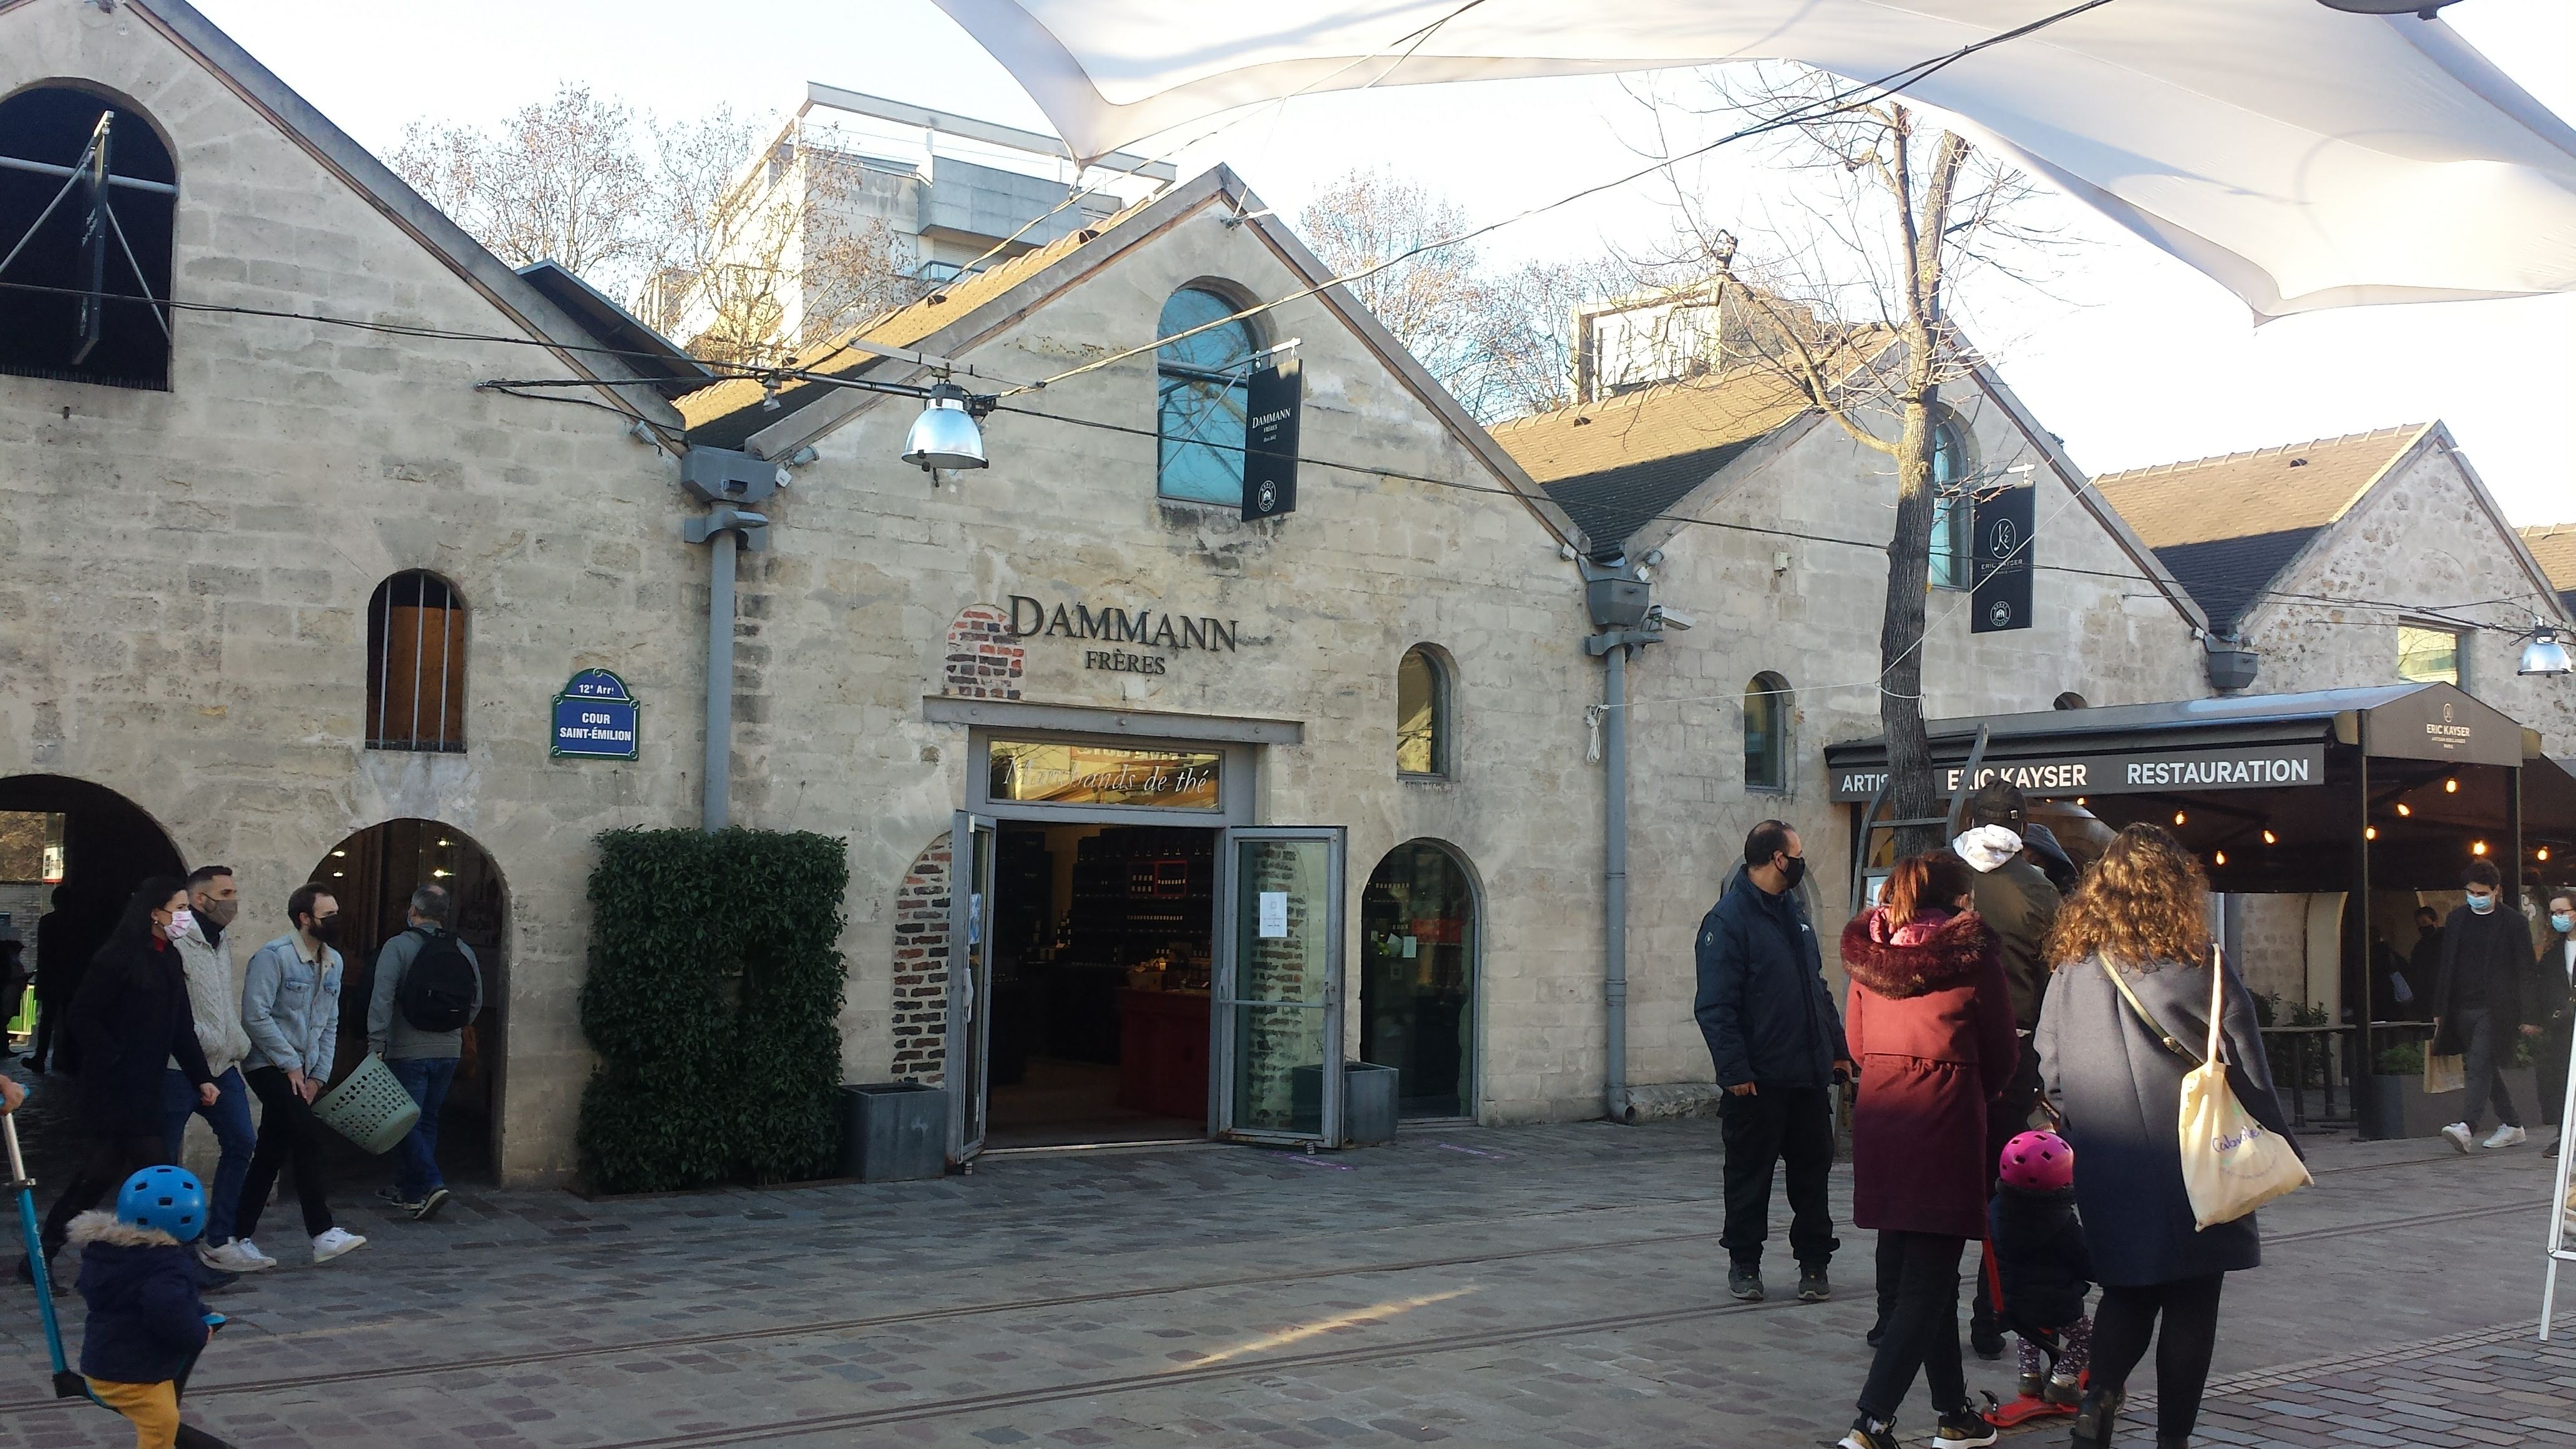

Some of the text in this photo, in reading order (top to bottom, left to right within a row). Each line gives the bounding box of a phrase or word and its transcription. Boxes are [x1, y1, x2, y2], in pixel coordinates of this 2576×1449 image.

[1252, 407, 1290, 429] DAMMANN
[1008, 595, 1239, 653] DAMMANN
[1086, 648, 1166, 675] FRÈRES
[582, 713, 610, 724] COUR
[2427, 723, 2470, 737] ERIC KAYSER
[560, 727, 632, 741] SAINT-ÉMILION
[1144, 766, 1167, 791] de
[1175, 768, 1209, 794] thé
[2127, 759, 2308, 784] RESTAURATION
